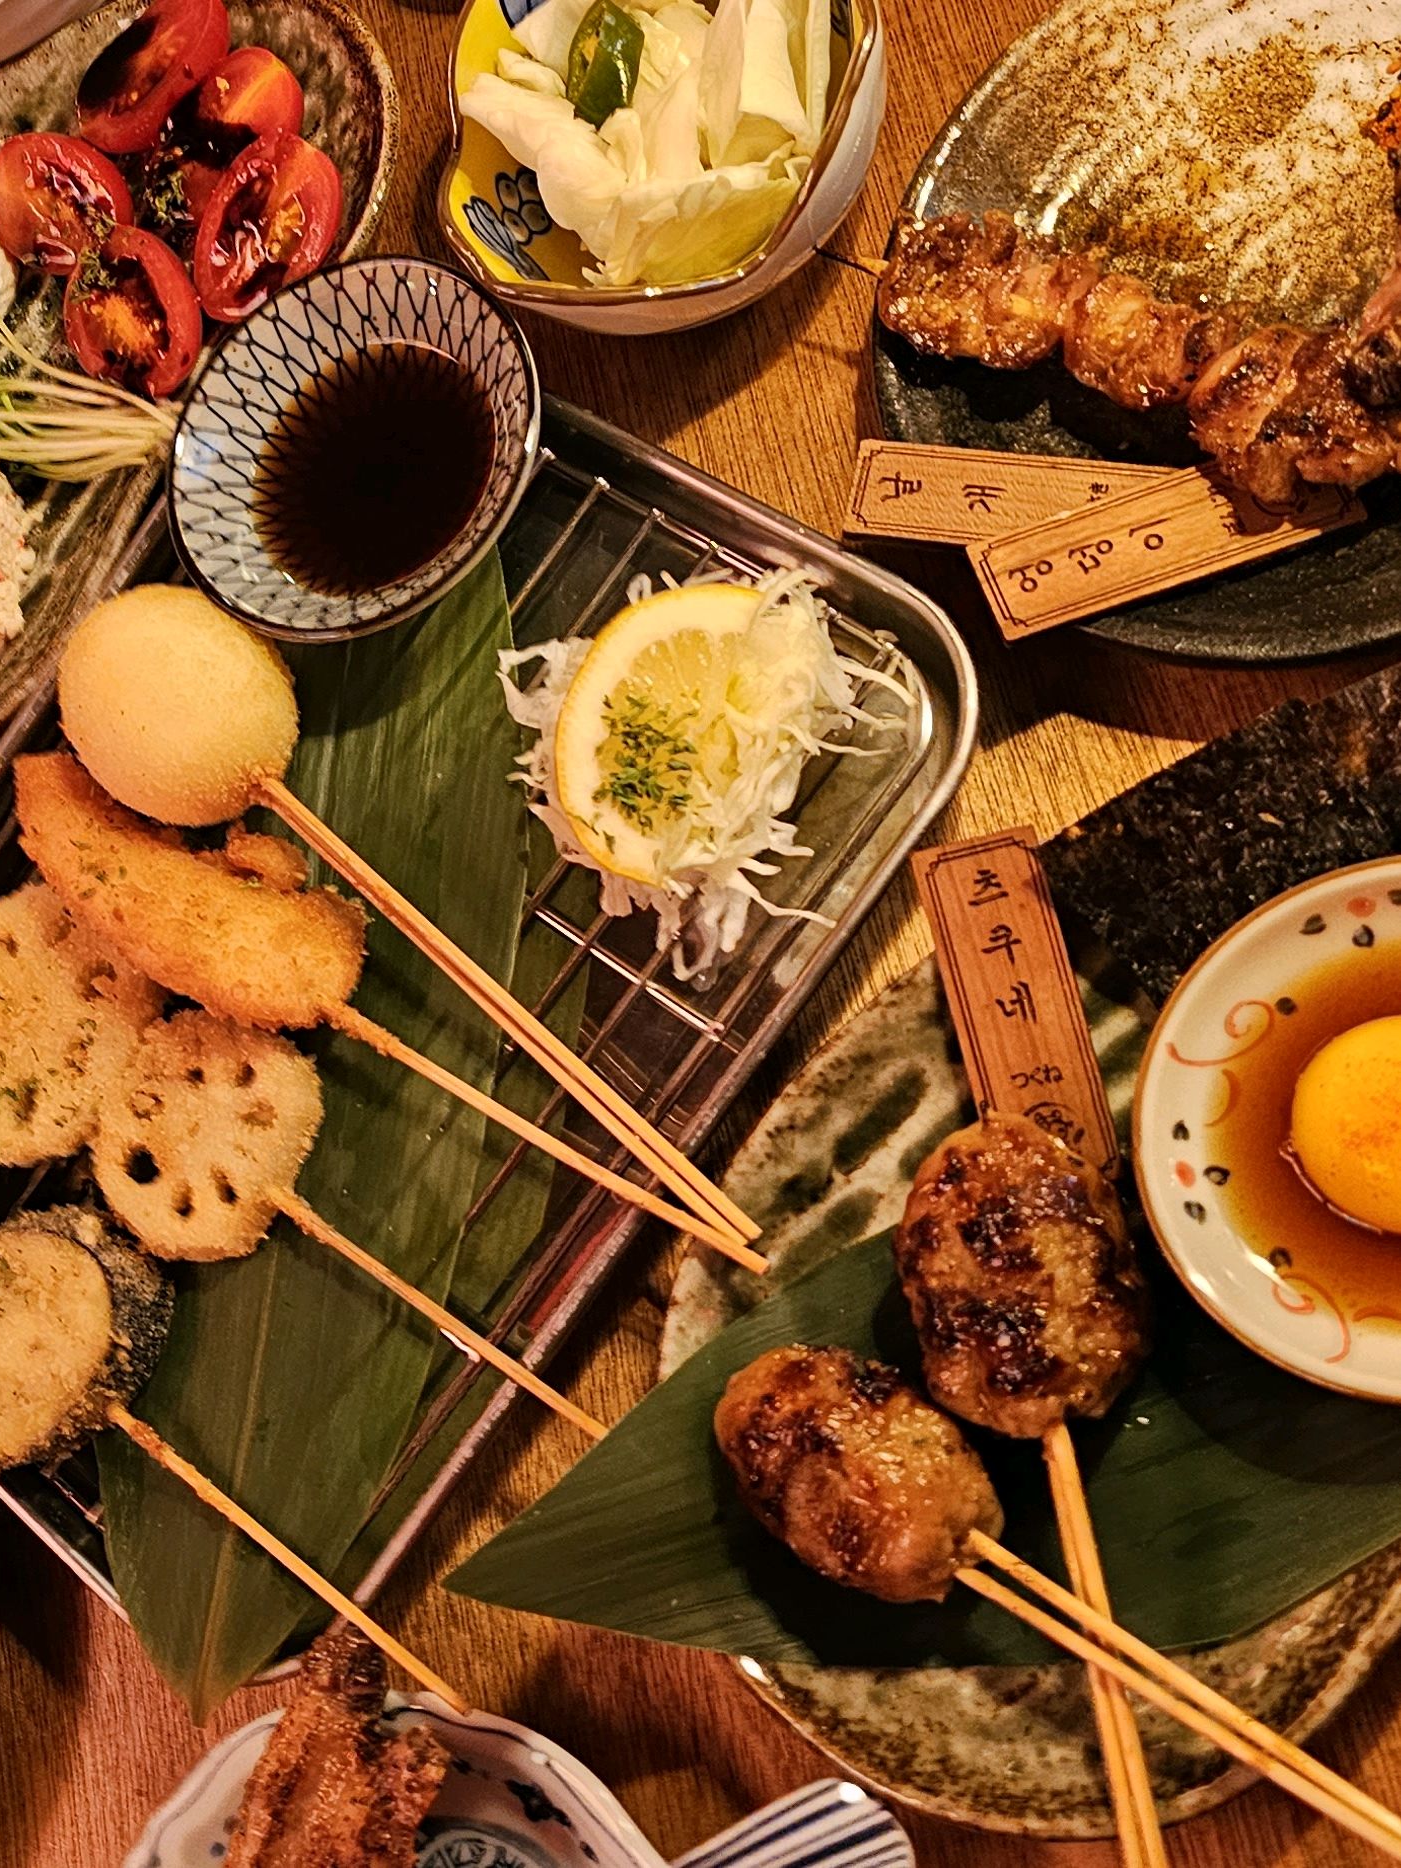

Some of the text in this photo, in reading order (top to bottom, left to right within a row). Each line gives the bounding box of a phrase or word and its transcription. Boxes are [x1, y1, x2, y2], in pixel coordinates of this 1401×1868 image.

[879, 471, 1007, 513] 날개
[1008, 517, 1172, 593] 엉덩이
[968, 869, 1037, 1023] 츠쿠네
[1010, 1063, 1064, 1089] つくね
